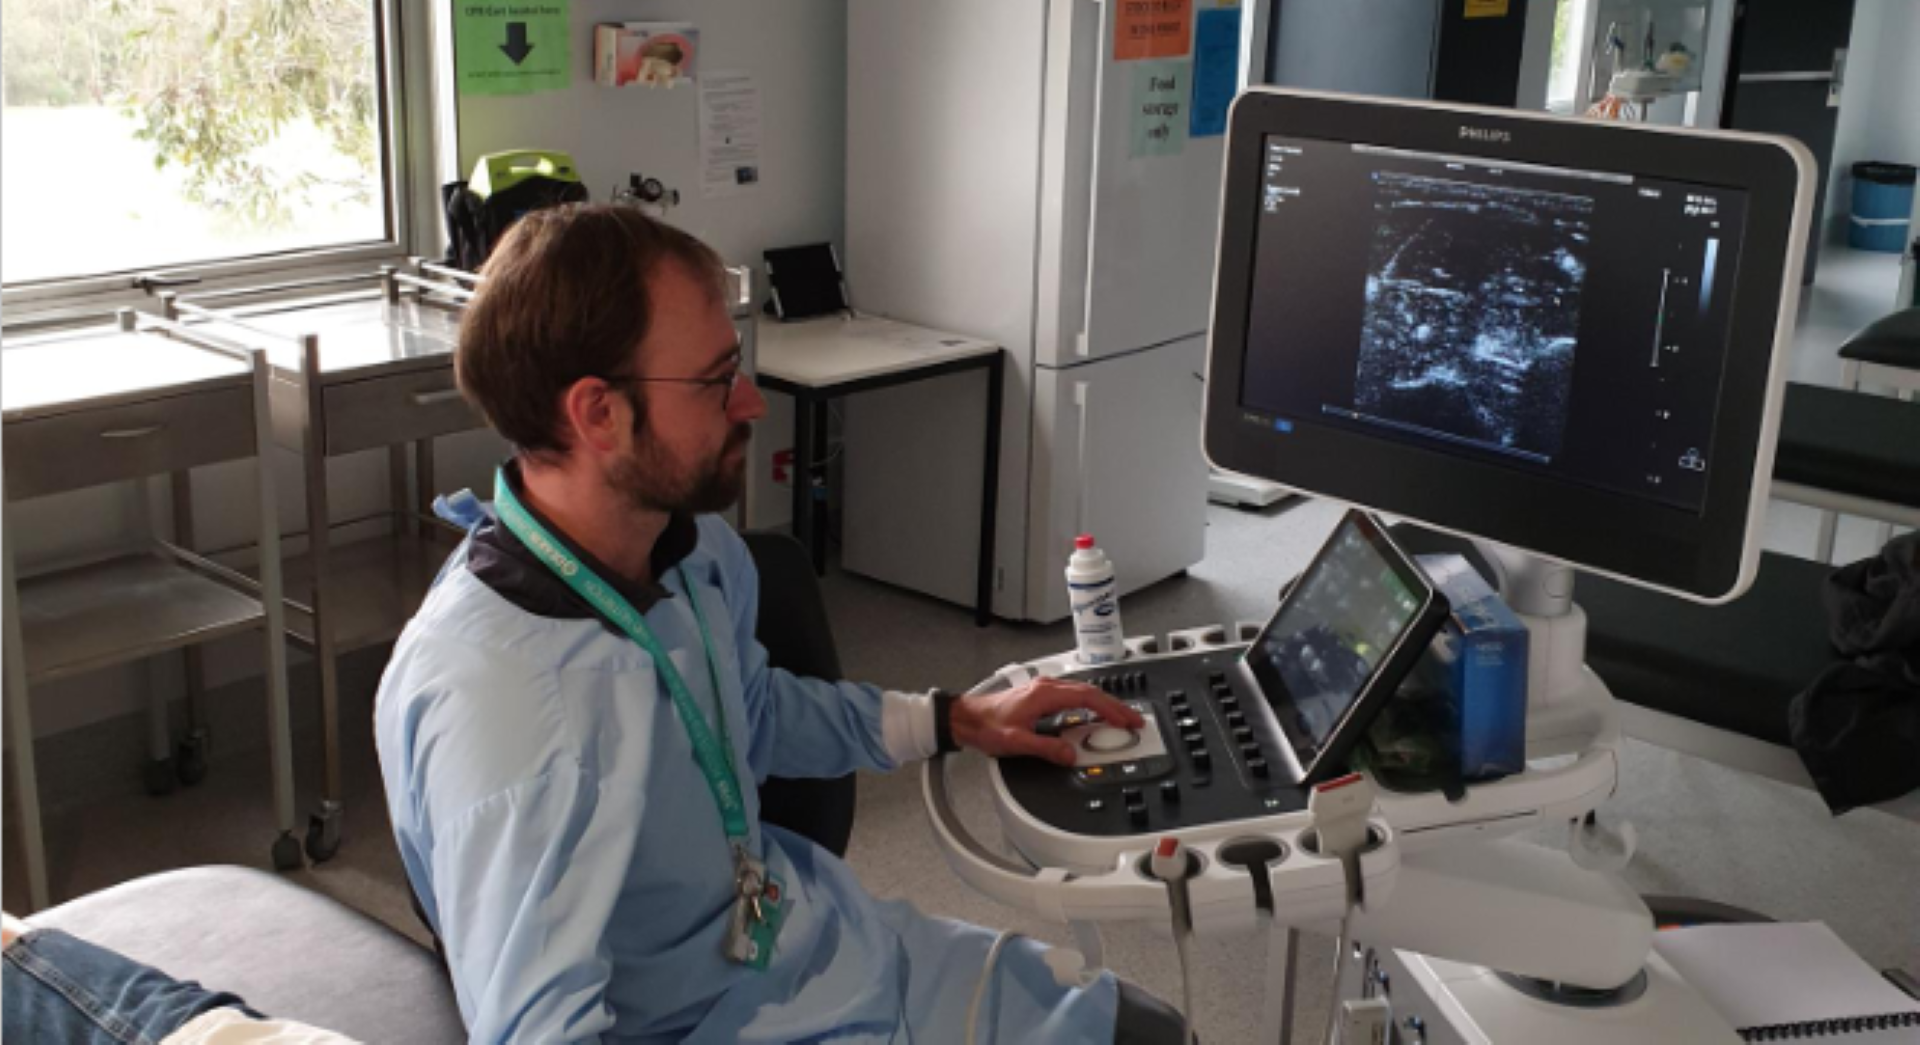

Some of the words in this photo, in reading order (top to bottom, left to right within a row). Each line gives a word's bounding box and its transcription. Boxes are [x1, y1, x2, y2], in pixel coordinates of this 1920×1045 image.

[1149, 75, 1175, 91] Food
[1148, 122, 1169, 142] only
[1459, 126, 1511, 142] PHILIPS
